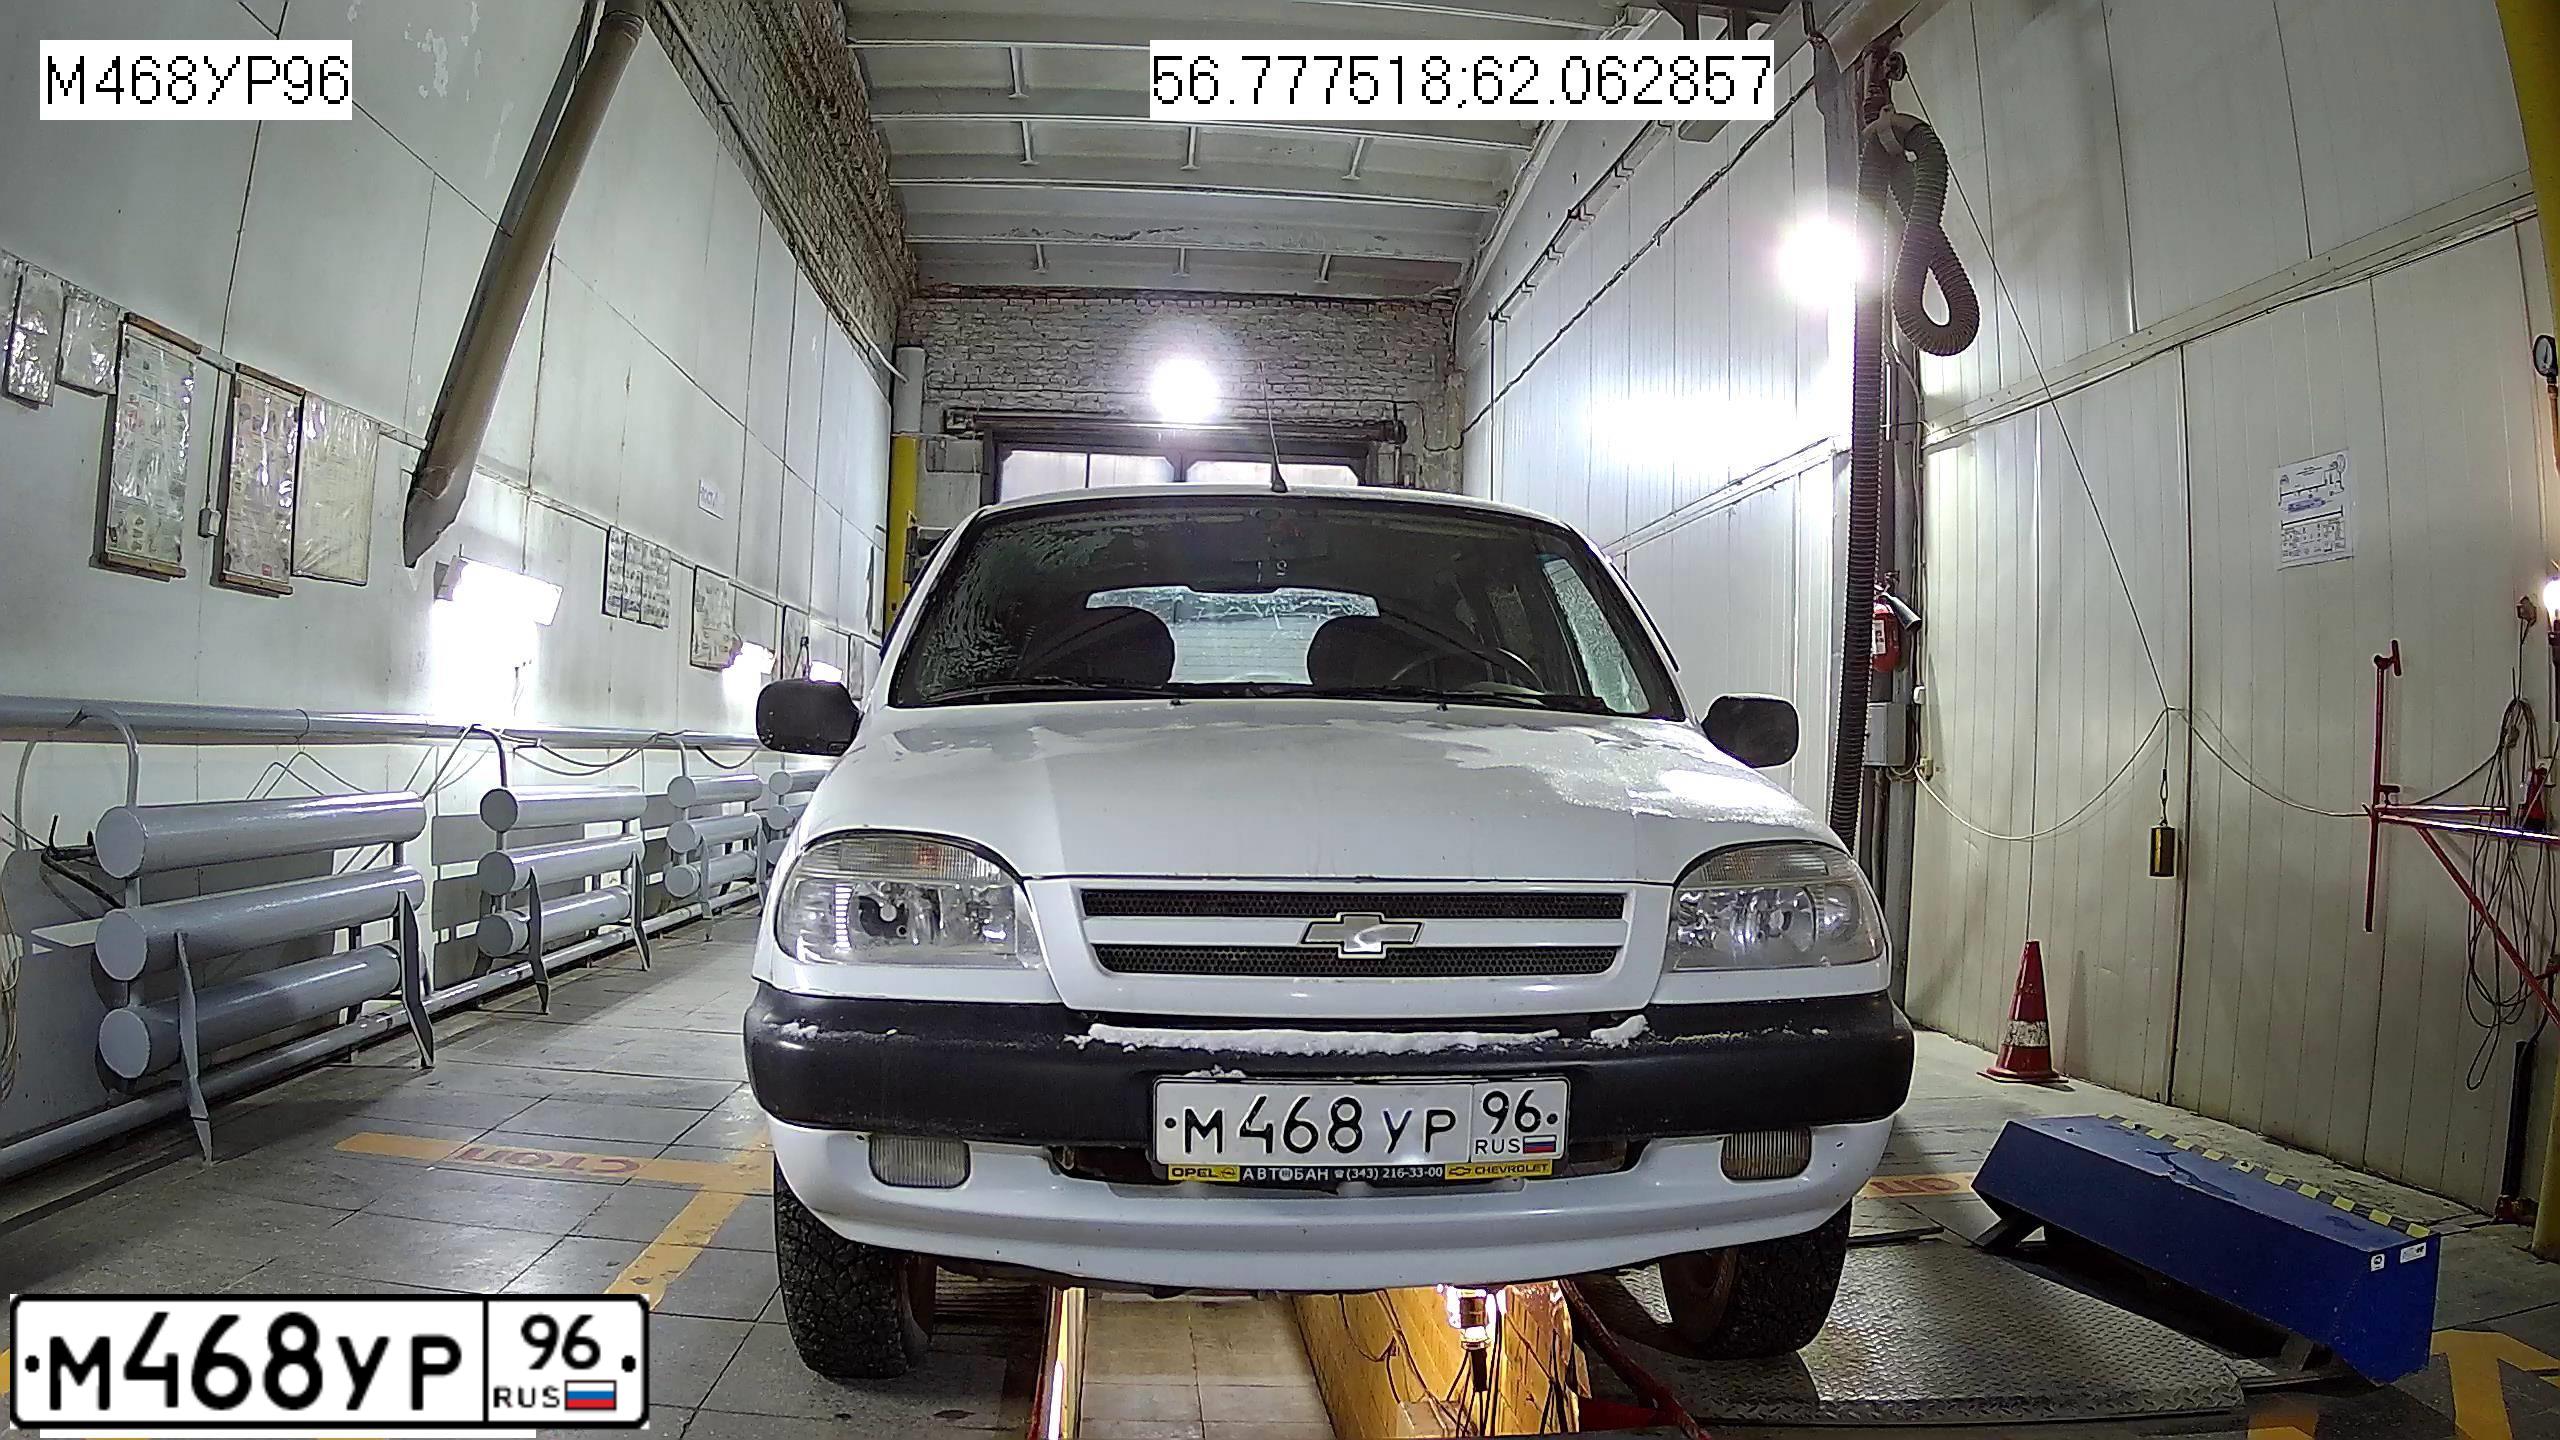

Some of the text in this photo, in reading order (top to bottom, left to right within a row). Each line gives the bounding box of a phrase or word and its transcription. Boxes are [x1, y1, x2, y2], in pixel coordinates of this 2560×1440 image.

[1481, 1088, 1543, 1135] 96
[1474, 1138, 1521, 1155] RUS
[1170, 1166, 1218, 1178] OPEL
[1346, 1167, 1379, 1181] (343)
[1382, 1166, 1443, 1179] 216-33-00
[1473, 1163, 1549, 1176] CHEVROLET
